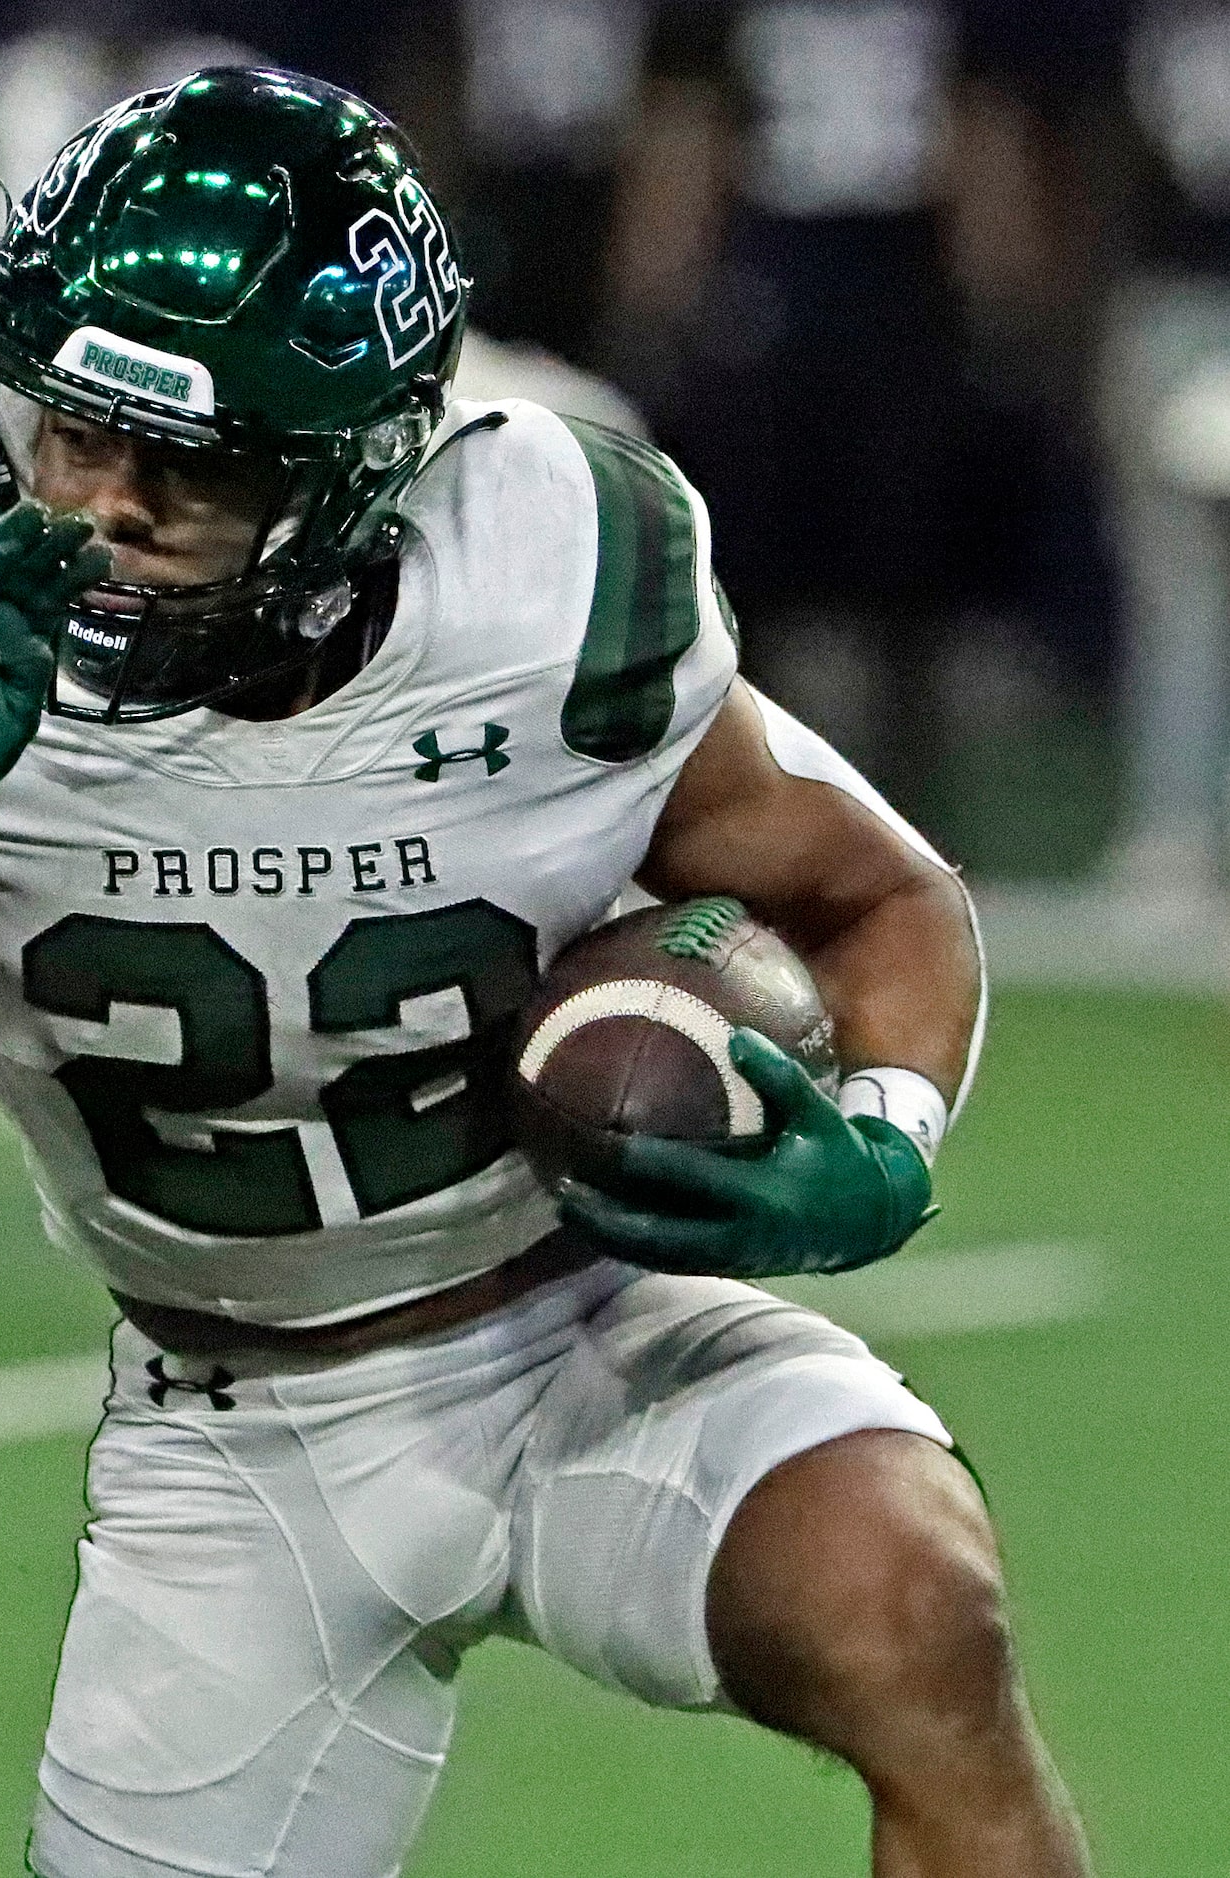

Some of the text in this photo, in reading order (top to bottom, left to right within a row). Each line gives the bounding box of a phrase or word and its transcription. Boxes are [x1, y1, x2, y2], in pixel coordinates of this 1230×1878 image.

[348, 173, 462, 371] 22
[80, 340, 192, 403] PROSPER
[67, 618, 128, 651] Riddell
[104, 834, 438, 897] PROSPER
[21, 897, 538, 1238] 22
